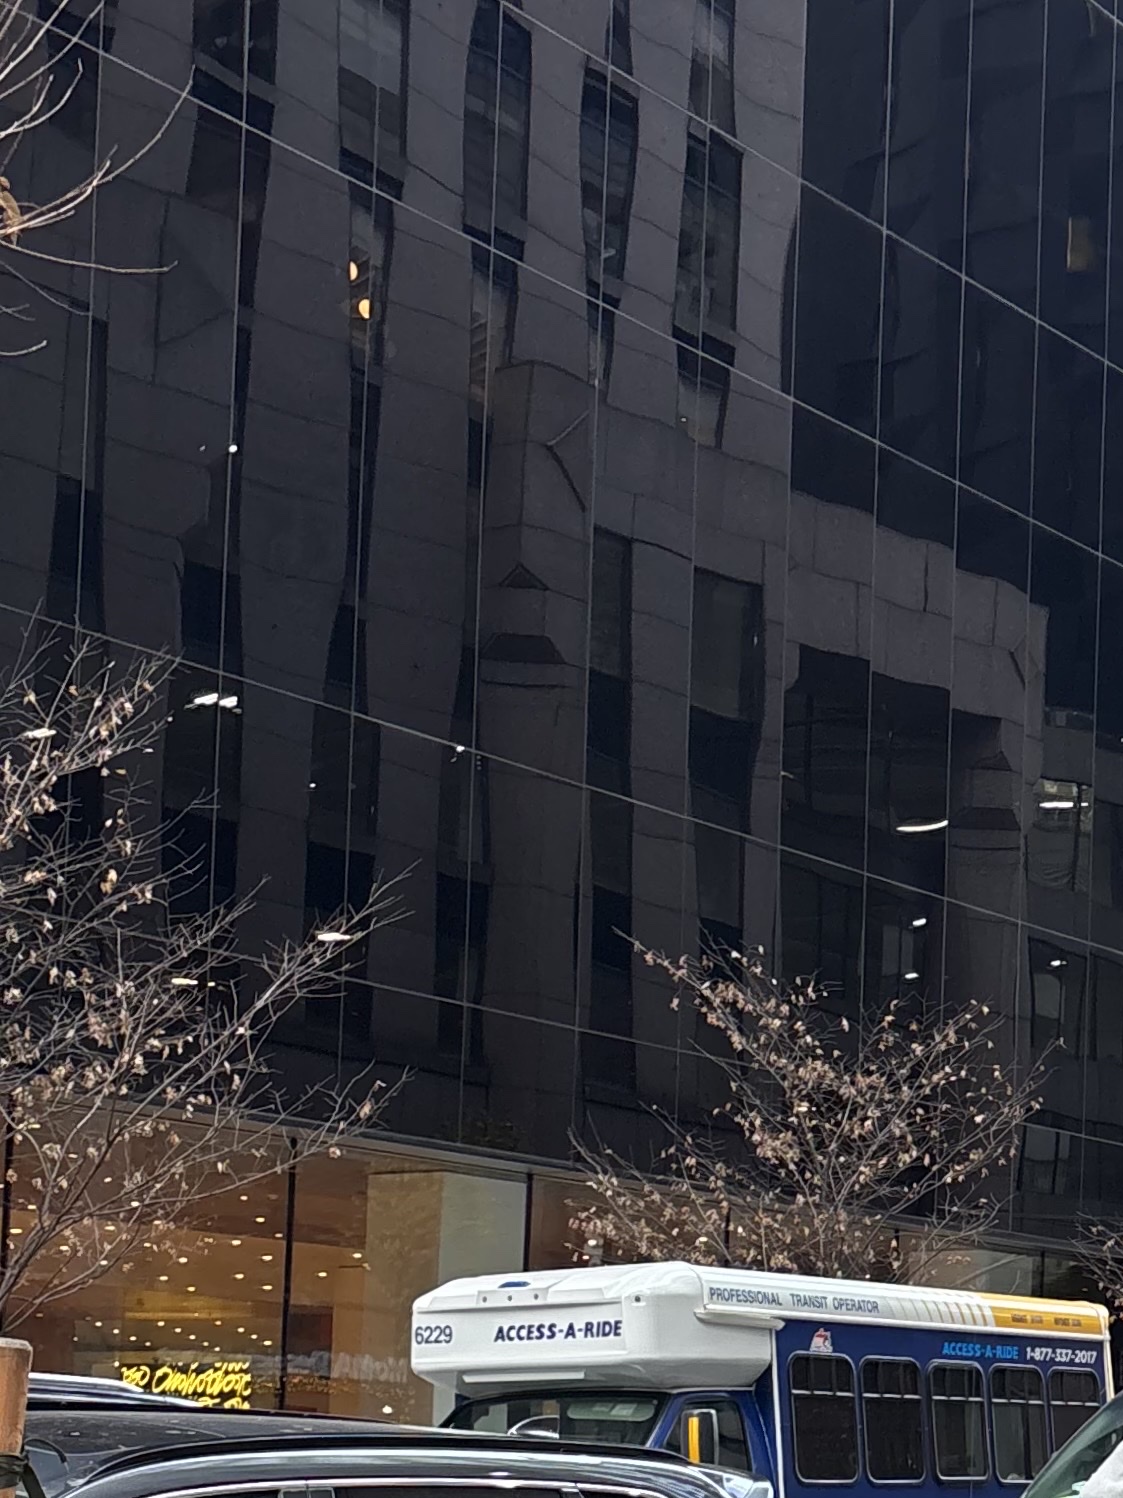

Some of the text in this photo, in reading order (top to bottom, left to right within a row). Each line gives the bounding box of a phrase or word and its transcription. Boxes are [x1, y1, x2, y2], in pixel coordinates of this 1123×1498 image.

[709, 1286, 880, 1314] PROFESSIONAL TRANSIT OPERATOR
[414, 1325, 453, 1345] 6229
[494, 1319, 623, 1343] ACCESS-A-RIDE
[941, 1341, 1098, 1364] ACCESS-A-RIDE 1-877-337-2017
